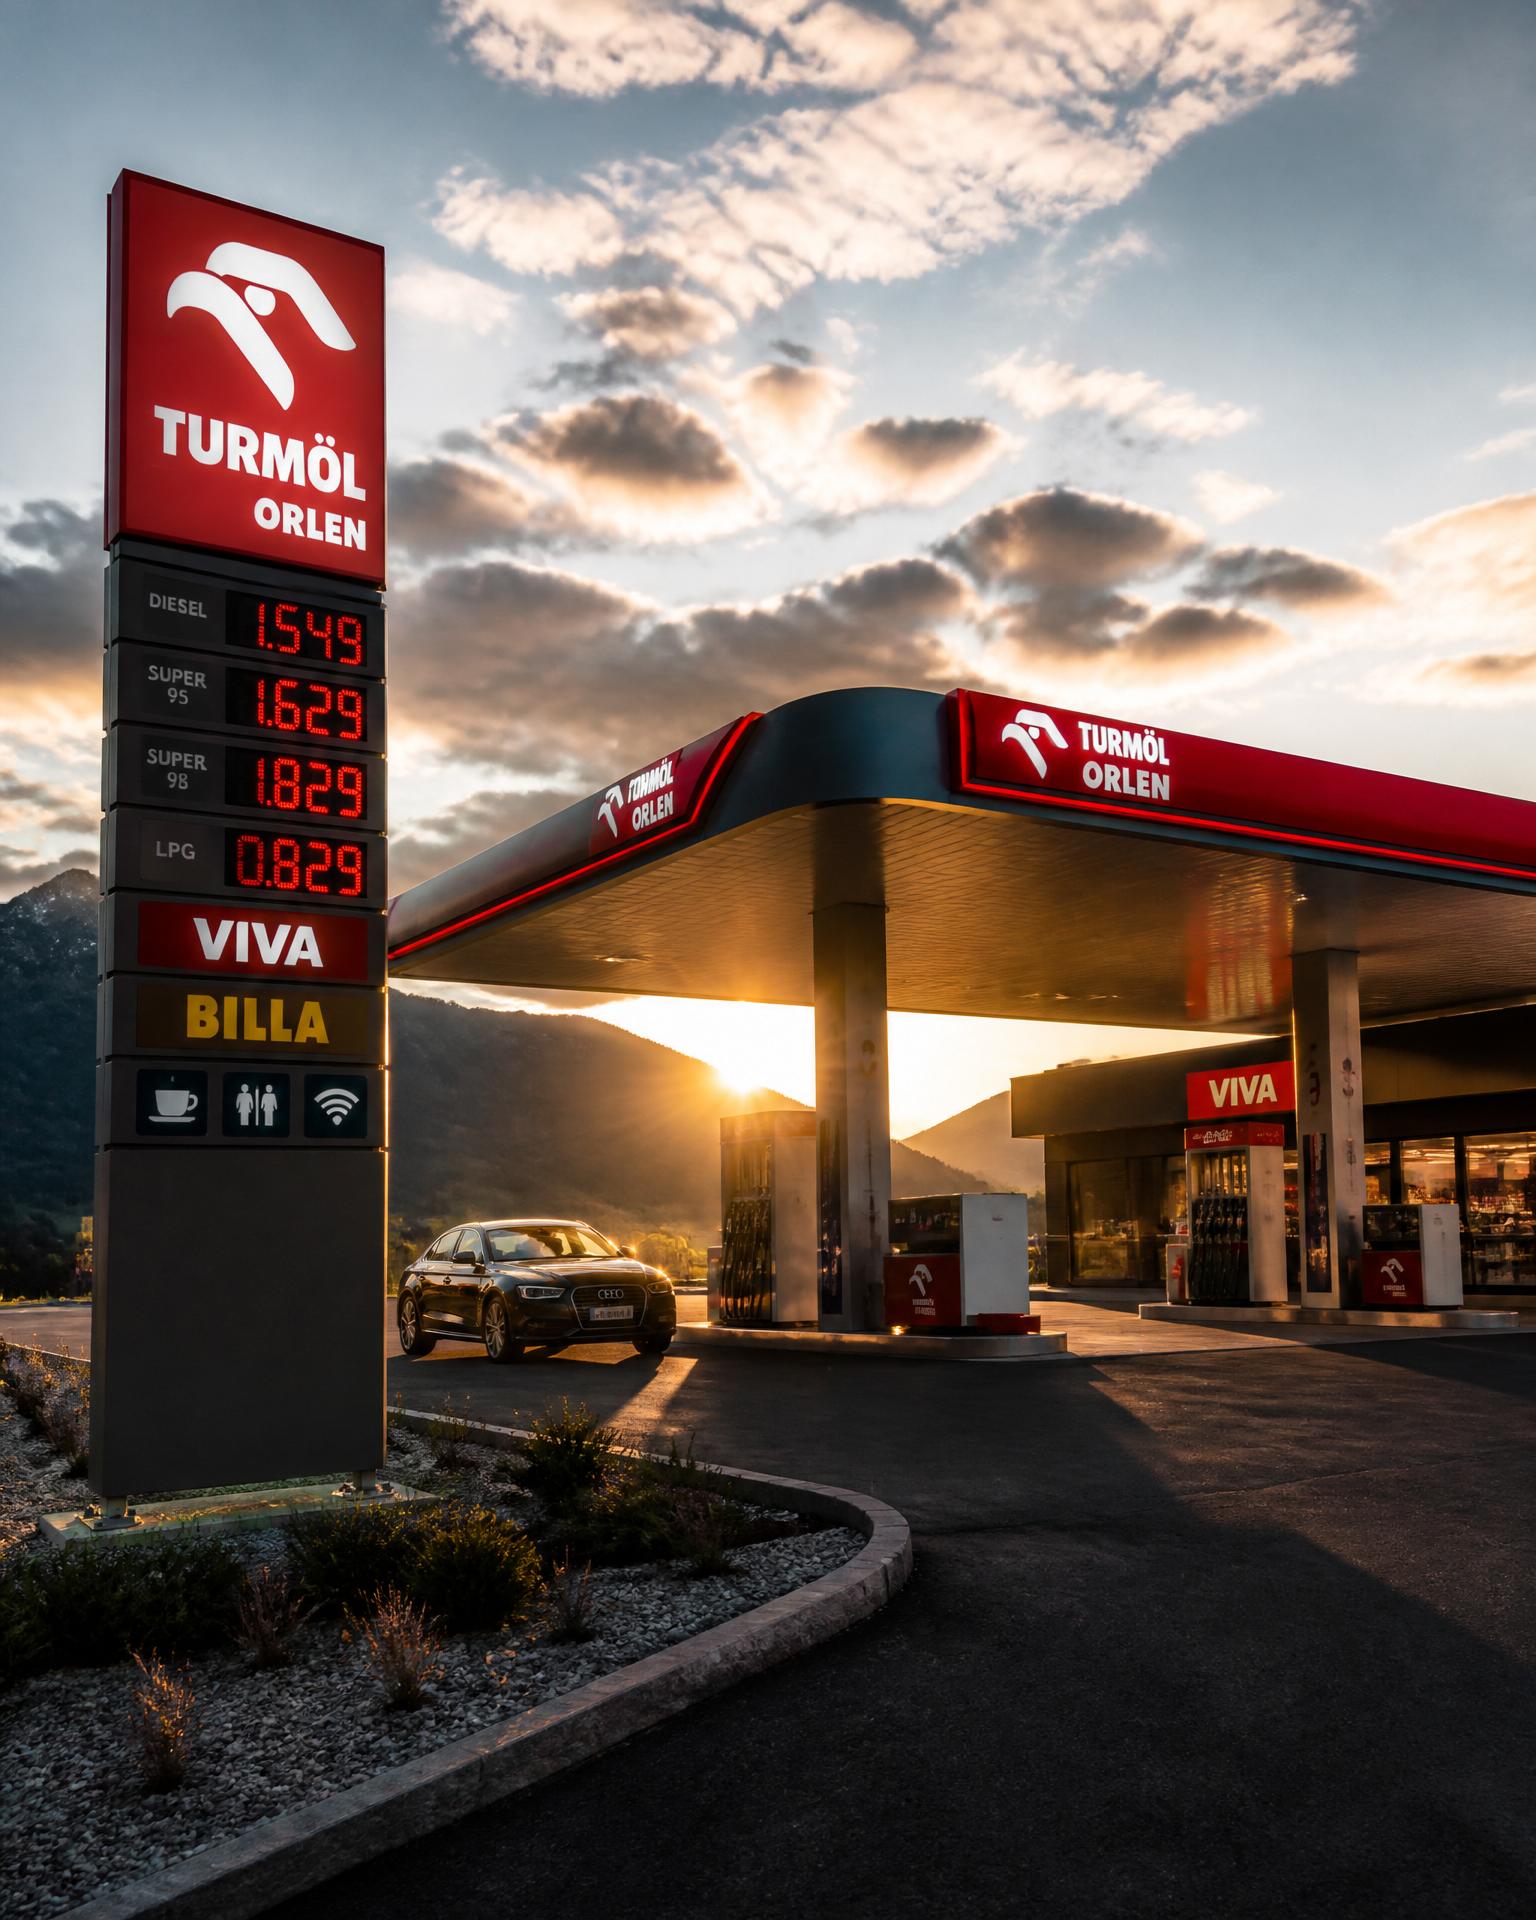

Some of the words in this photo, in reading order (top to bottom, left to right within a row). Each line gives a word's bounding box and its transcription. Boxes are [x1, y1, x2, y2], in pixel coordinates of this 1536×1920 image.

[154, 405, 366, 502] TURMÖL
[254, 497, 366, 551] ORLEN
[149, 593, 207, 618] DIESEL
[257, 602, 362, 665] 1.549
[148, 665, 207, 689] SUPER
[167, 688, 189, 705] 95
[257, 679, 362, 740] 1.629
[146, 748, 207, 771] SUPER
[1078, 721, 1170, 766] TURMÖL
[167, 771, 189, 790] 98
[257, 757, 362, 817] 1.829
[1082, 760, 1170, 801] ORLEN
[632, 790, 674, 832] ORLEN
[155, 840, 196, 860] LPG
[236, 834, 362, 896] 0.829
[193, 917, 324, 968] VIVA
[186, 994, 330, 1044] BILLA
[1208, 1073, 1278, 1108] VIVA
